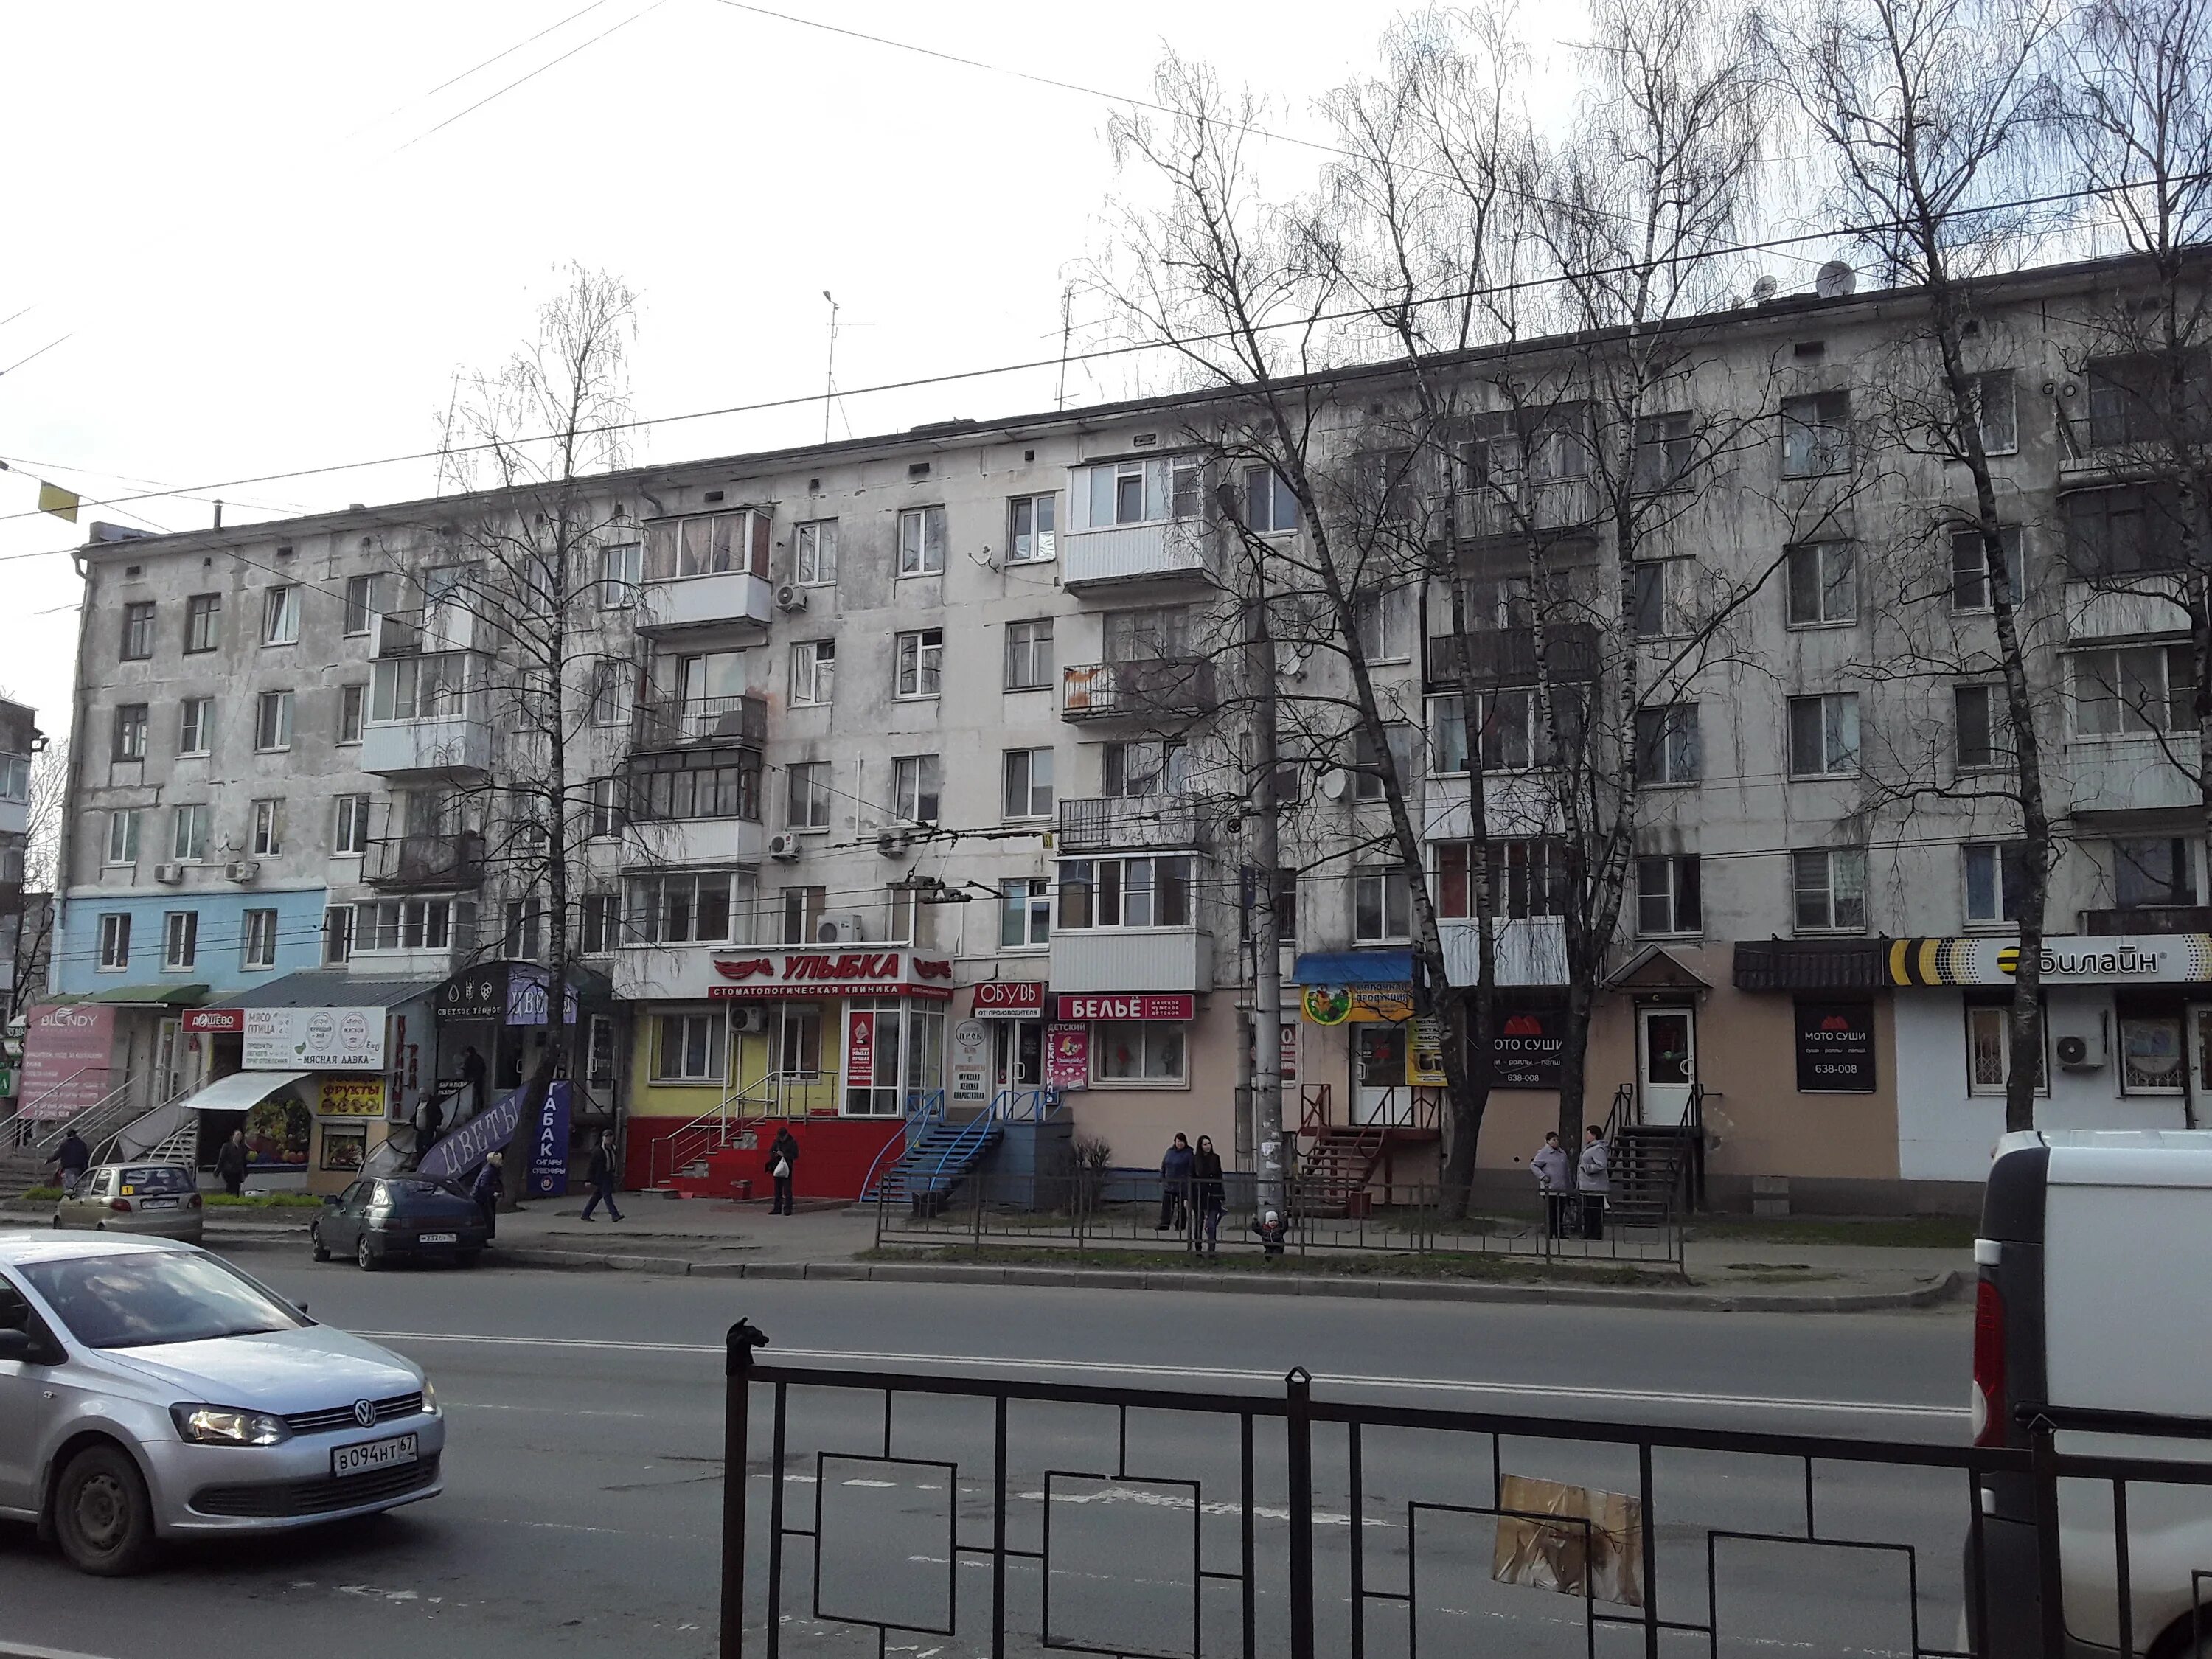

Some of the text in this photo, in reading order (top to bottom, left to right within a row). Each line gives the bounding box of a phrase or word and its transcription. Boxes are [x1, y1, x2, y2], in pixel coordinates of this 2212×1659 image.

[2040, 946, 2157, 973] билайн
[782, 953, 900, 980] УЛЫБКА
[714, 985, 898, 995] СТОМАТОЛОГИЧЕСКАЯ КЛИНИКА
[981, 984, 1035, 1005] ОБУВЬ
[512, 991, 571, 1017] ЦВЕЫ
[1072, 996, 1141, 1018] БЕЛЬЁ
[248, 1013, 271, 1022] МЯСО
[248, 1025, 275, 1034] ПТИЦА
[1048, 1023, 1085, 1032] ДЕТСКИЙ
[1805, 1032, 1865, 1040] МОТО СУШИ
[1494, 1039, 1520, 1050] ОТО
[304, 1056, 369, 1064] МЯСНАЯ ЛАВКА
[1815, 1065, 1857, 1074] 638-008
[323, 1085, 379, 1098] ФРУКТЫ
[440, 1096, 518, 1176] ЦВЕТЫ
[340, 1437, 412, 1469] В094НТ 67
